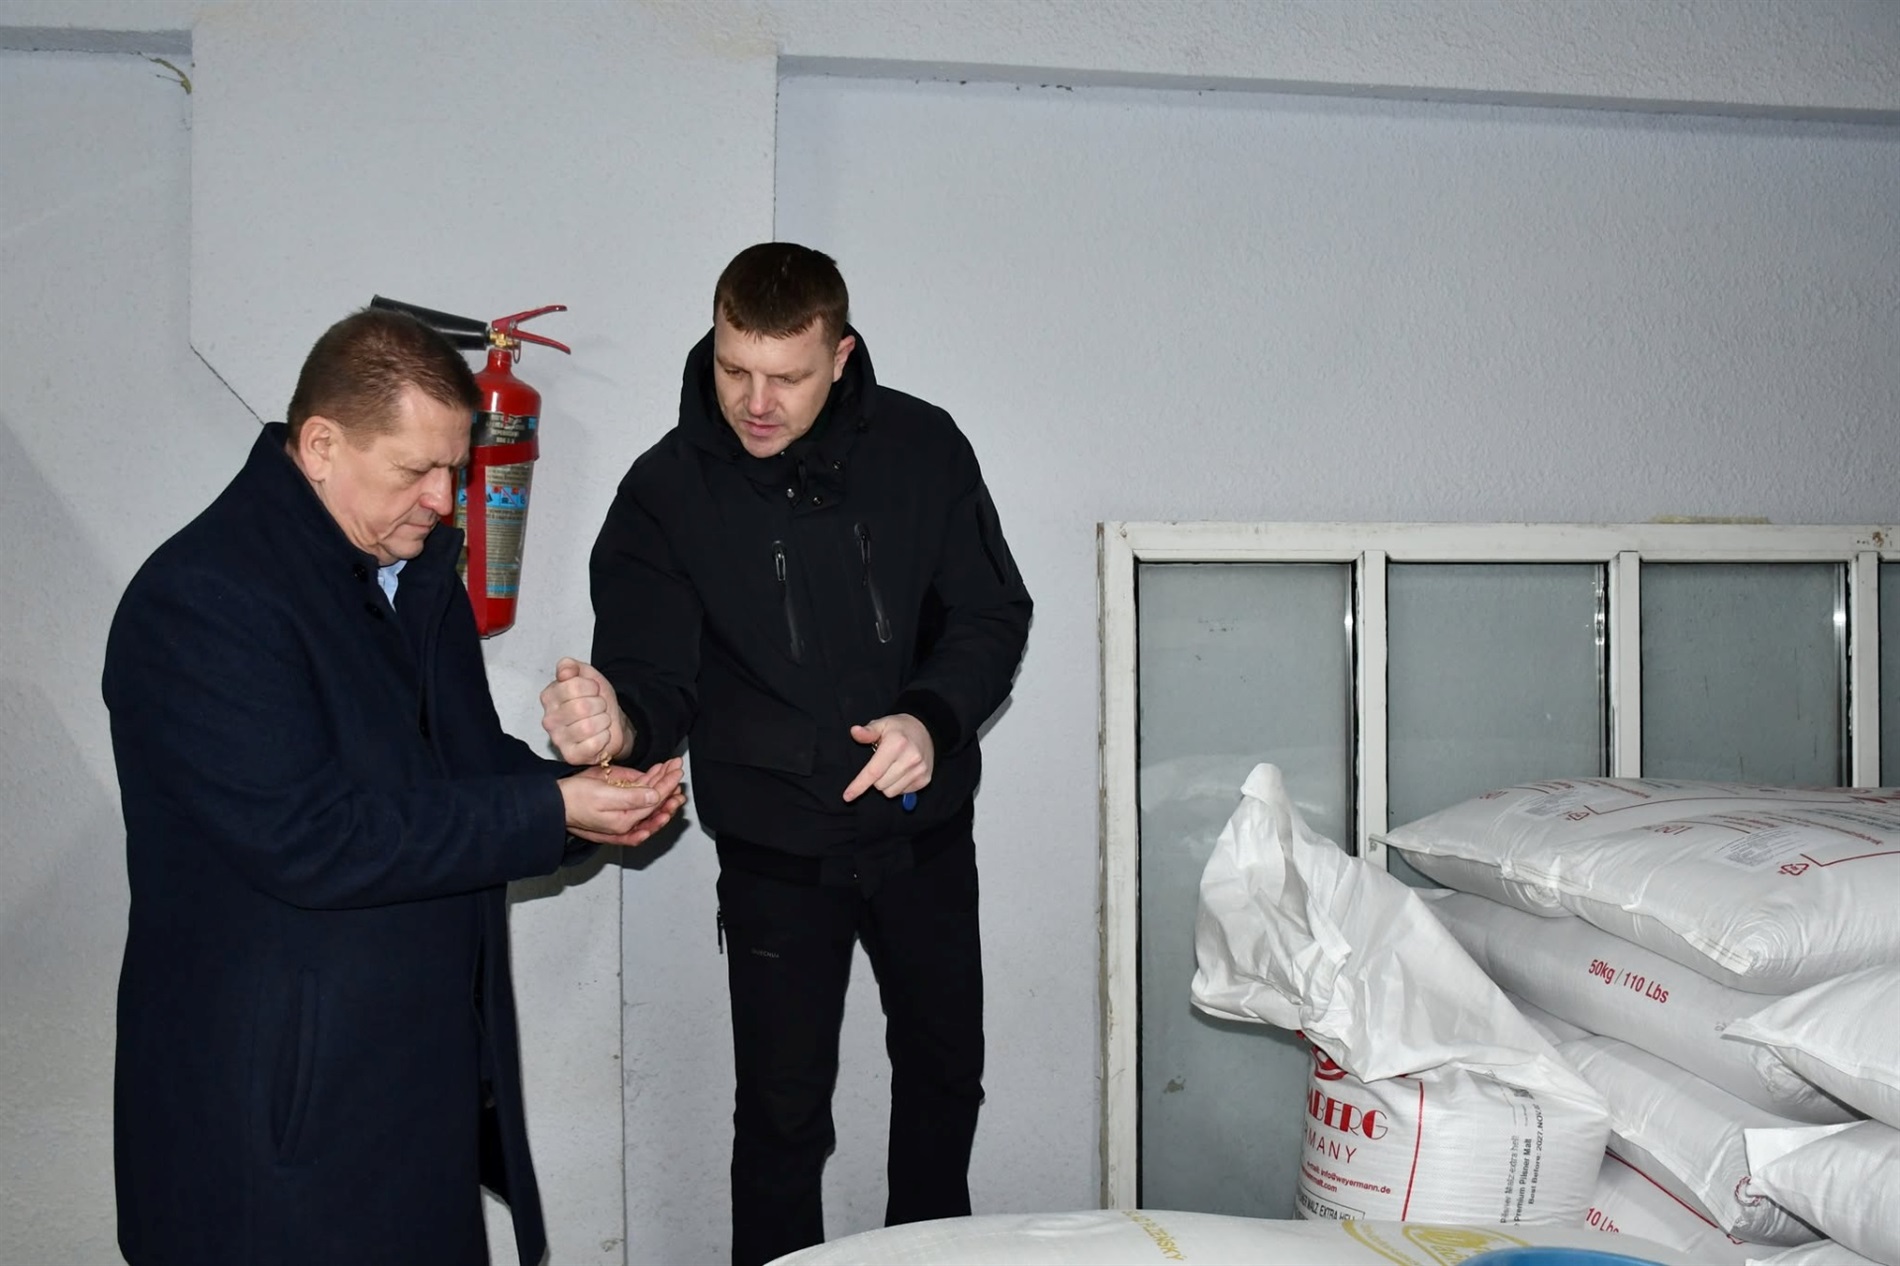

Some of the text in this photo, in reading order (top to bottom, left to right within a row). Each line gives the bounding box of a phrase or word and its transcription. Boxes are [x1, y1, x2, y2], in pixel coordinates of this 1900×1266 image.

[1588, 959, 1616, 985] 50kg
[1623, 971, 1646, 992] 110
[1645, 980, 1669, 1003] Lbs
[1523, 1138, 1533, 1156] Malt
[1320, 1168, 1391, 1195] info@weyermann.de
[1519, 1157, 1530, 1186] Pilsner
[1513, 1186, 1526, 1222] Premium
[1528, 1185, 1537, 1205] Best
[1319, 1204, 1338, 1220] EXTRA
